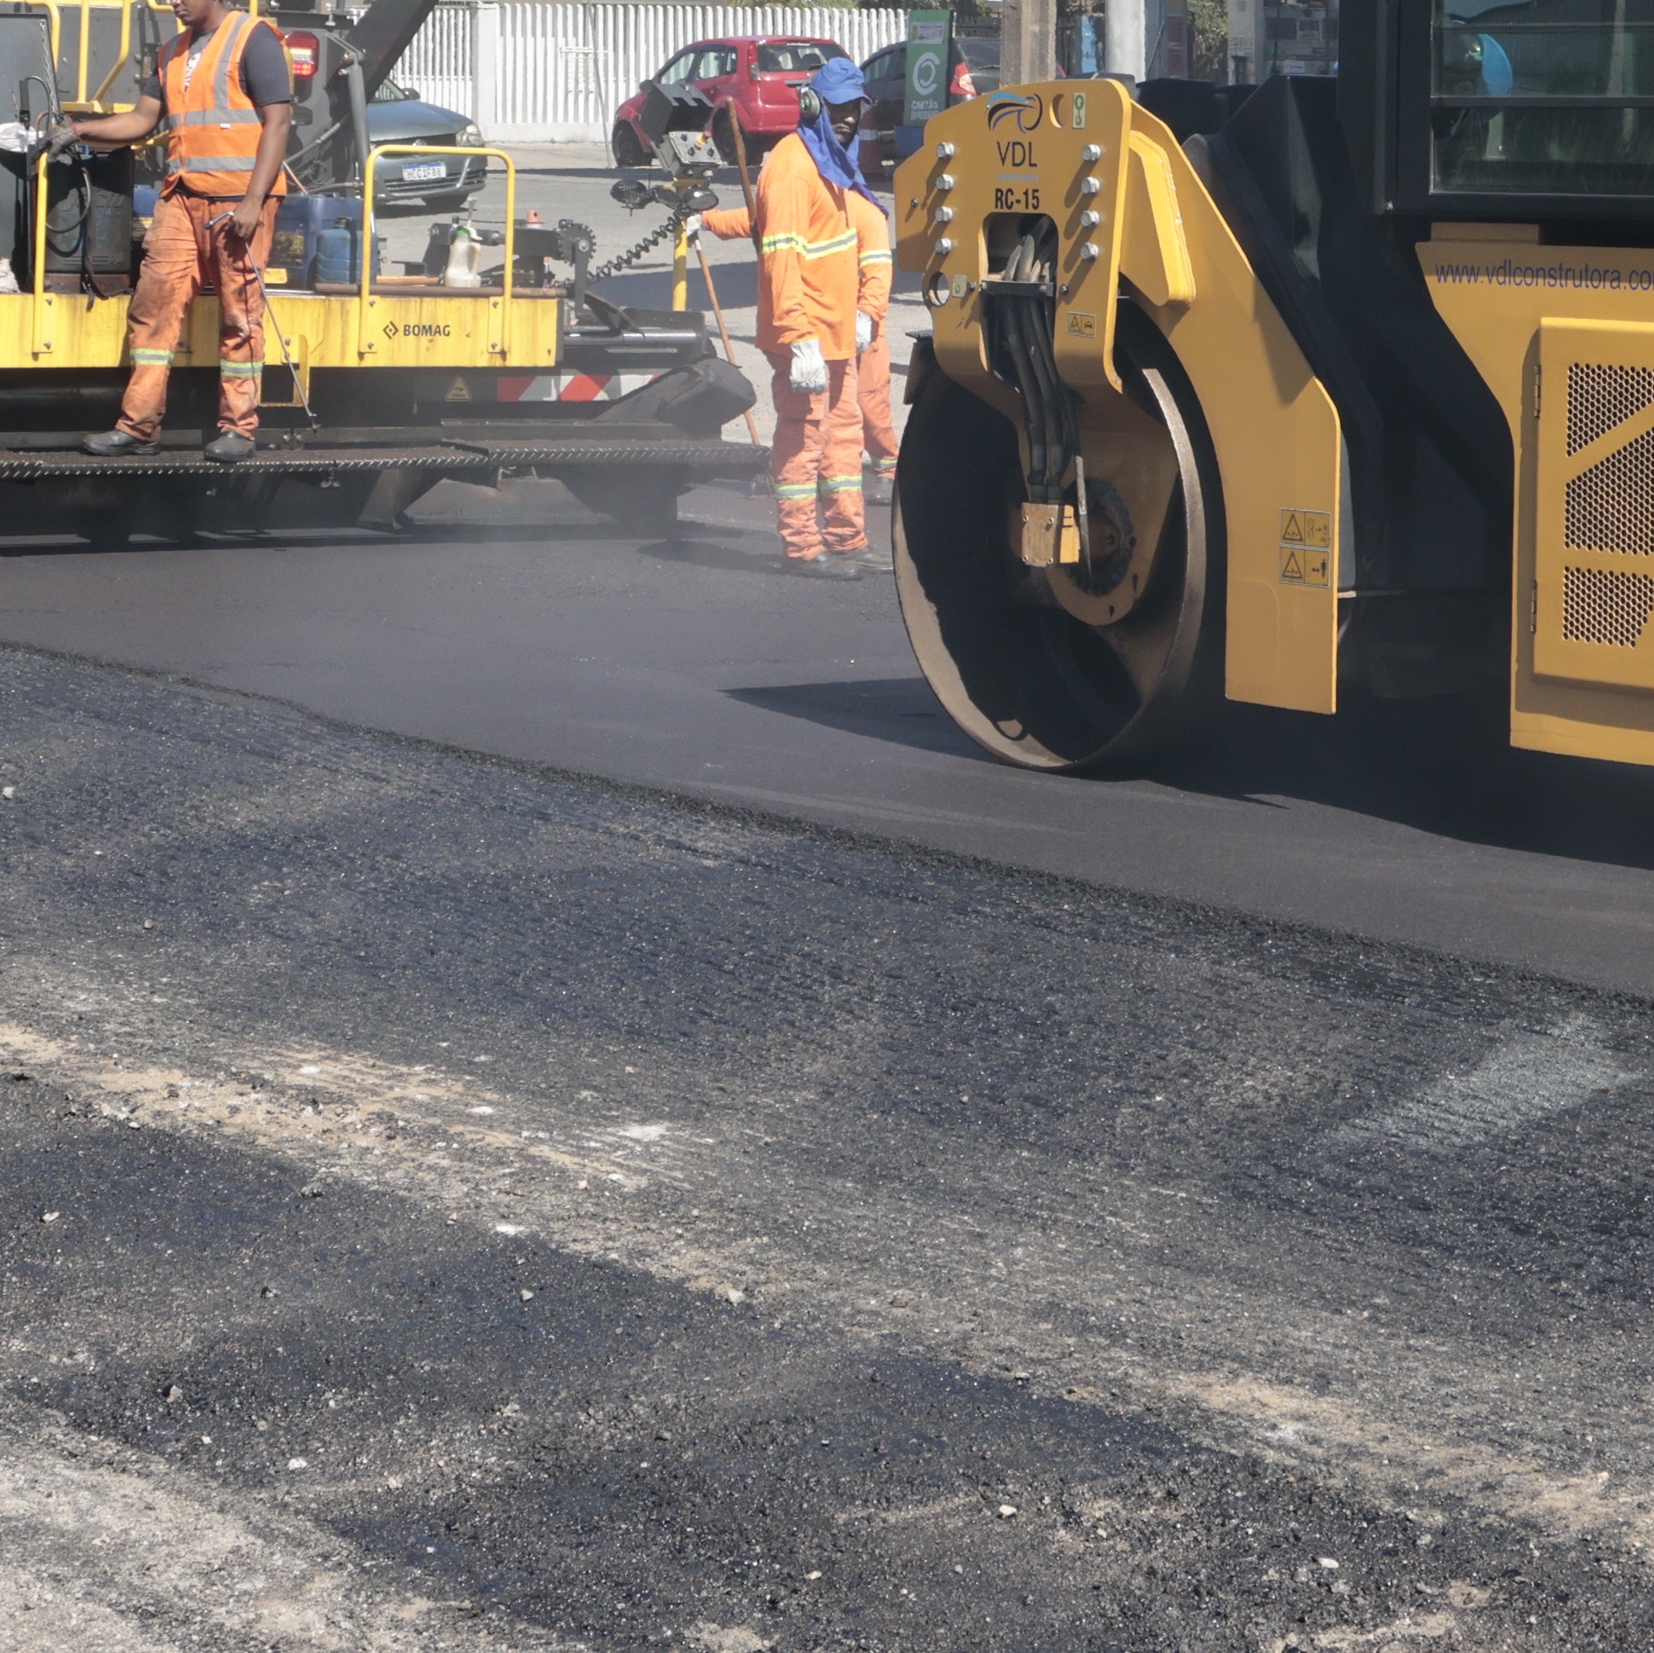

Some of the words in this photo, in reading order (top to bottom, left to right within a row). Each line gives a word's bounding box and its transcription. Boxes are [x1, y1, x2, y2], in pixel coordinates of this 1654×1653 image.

[996, 141, 1038, 167] VDL
[994, 187, 1040, 210] RC-15
[403, 324, 451, 337] BOMAG
